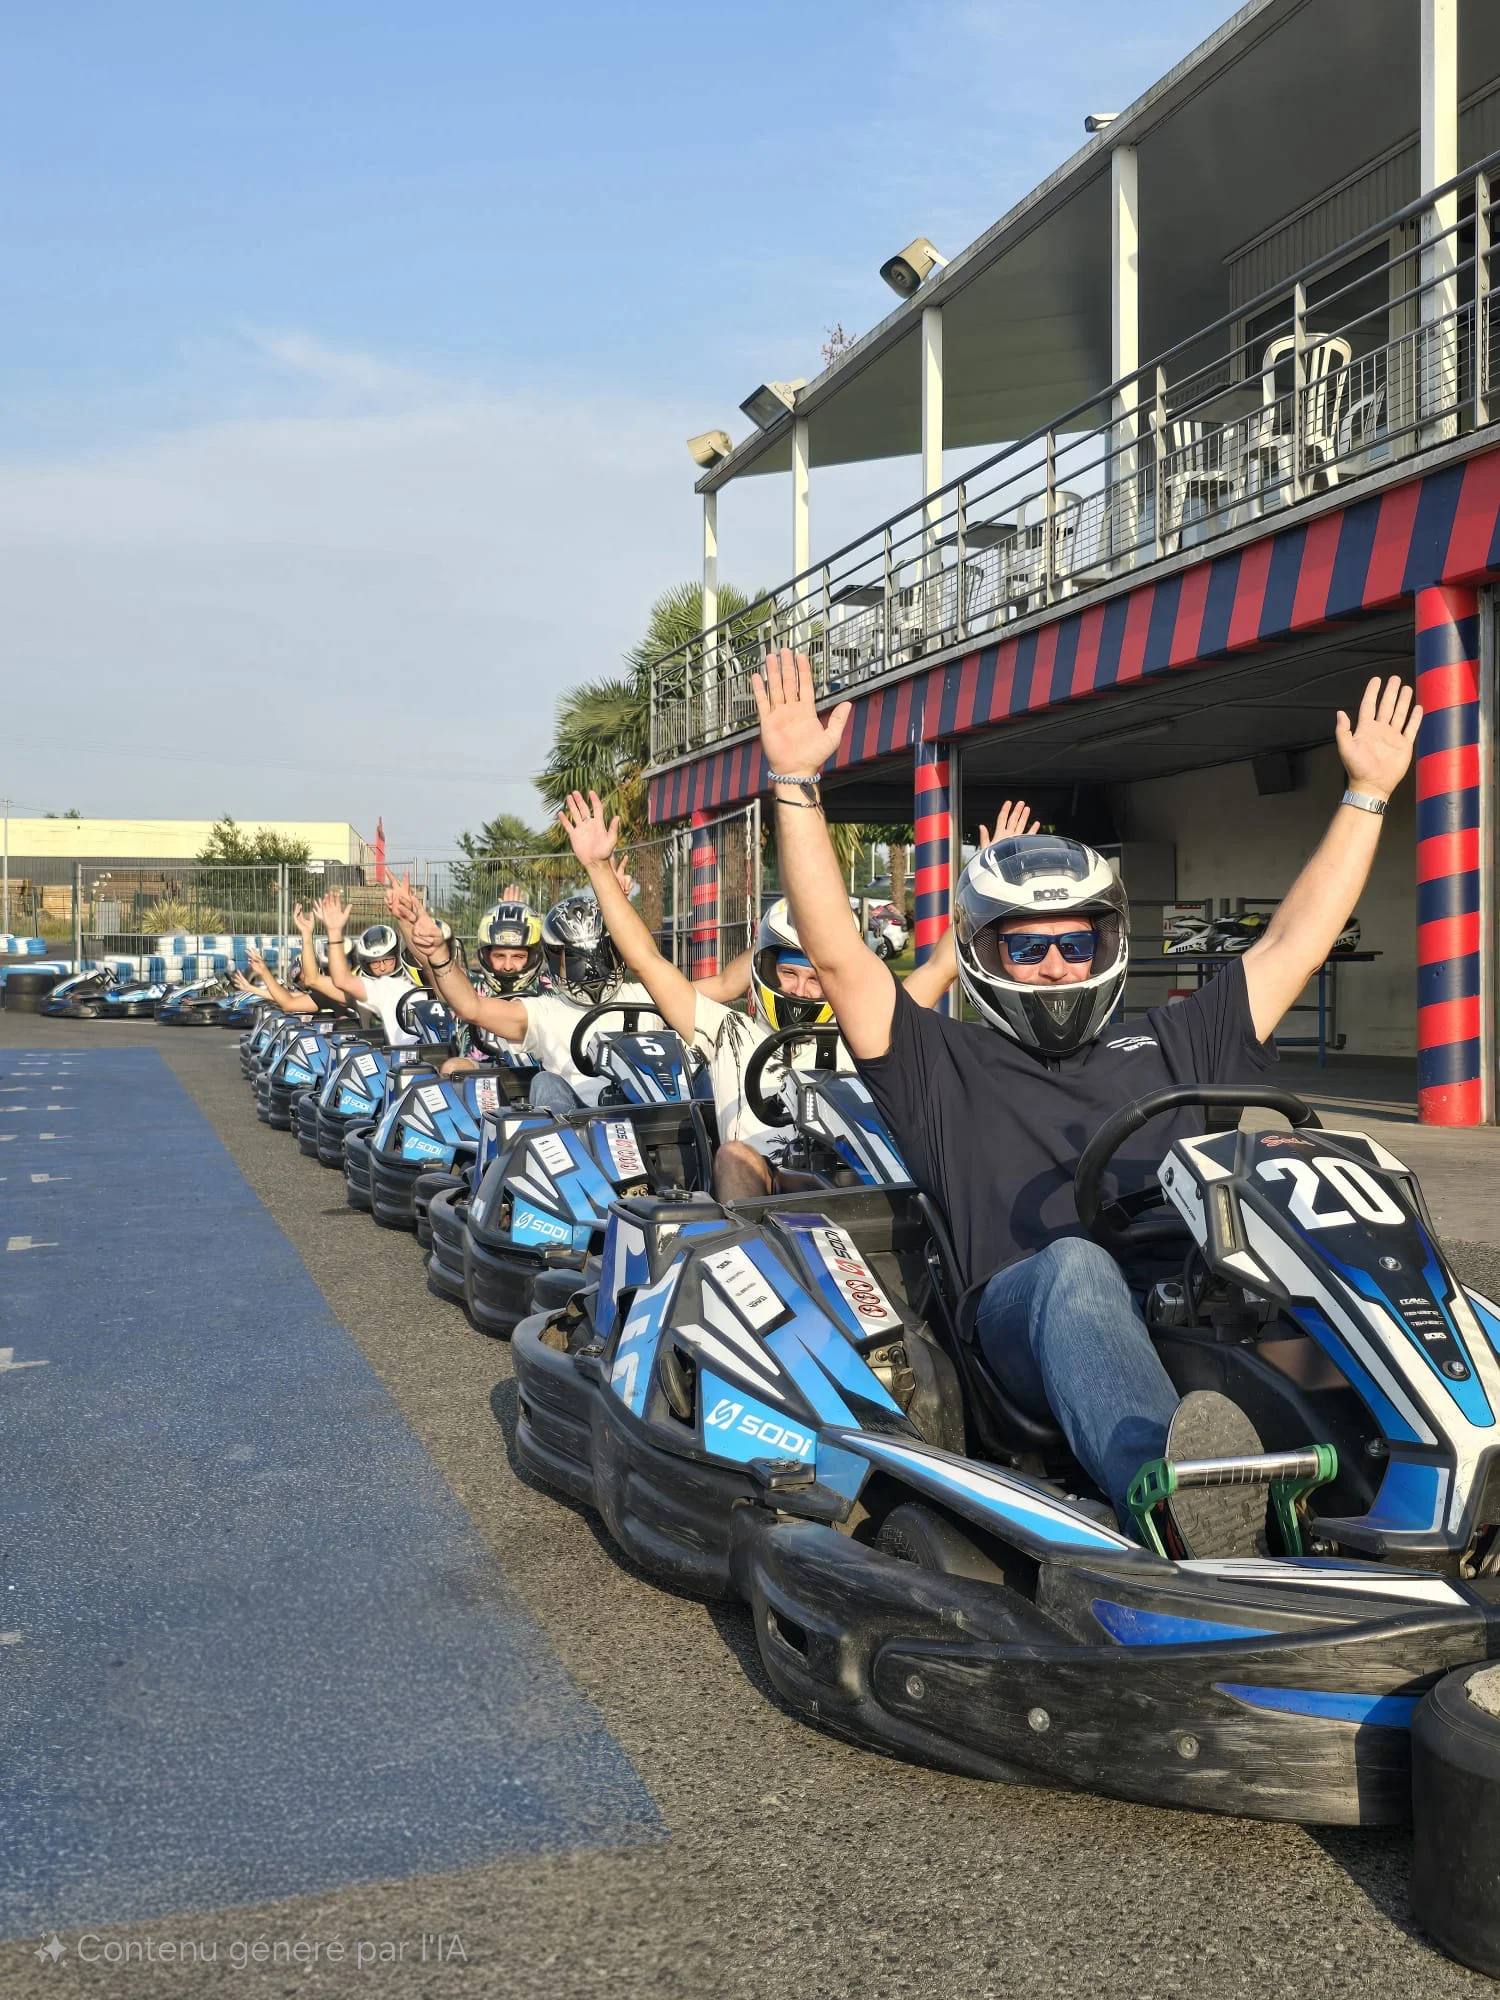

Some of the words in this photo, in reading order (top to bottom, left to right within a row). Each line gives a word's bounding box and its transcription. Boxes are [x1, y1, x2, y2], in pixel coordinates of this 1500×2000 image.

[430, 1003, 446, 1017] 4
[636, 1036, 666, 1056] 5
[416, 1141, 442, 1155] SODI
[1255, 1156, 1406, 1230] 20
[530, 1220, 569, 1241] SODI
[736, 1414, 813, 1457] SODI
